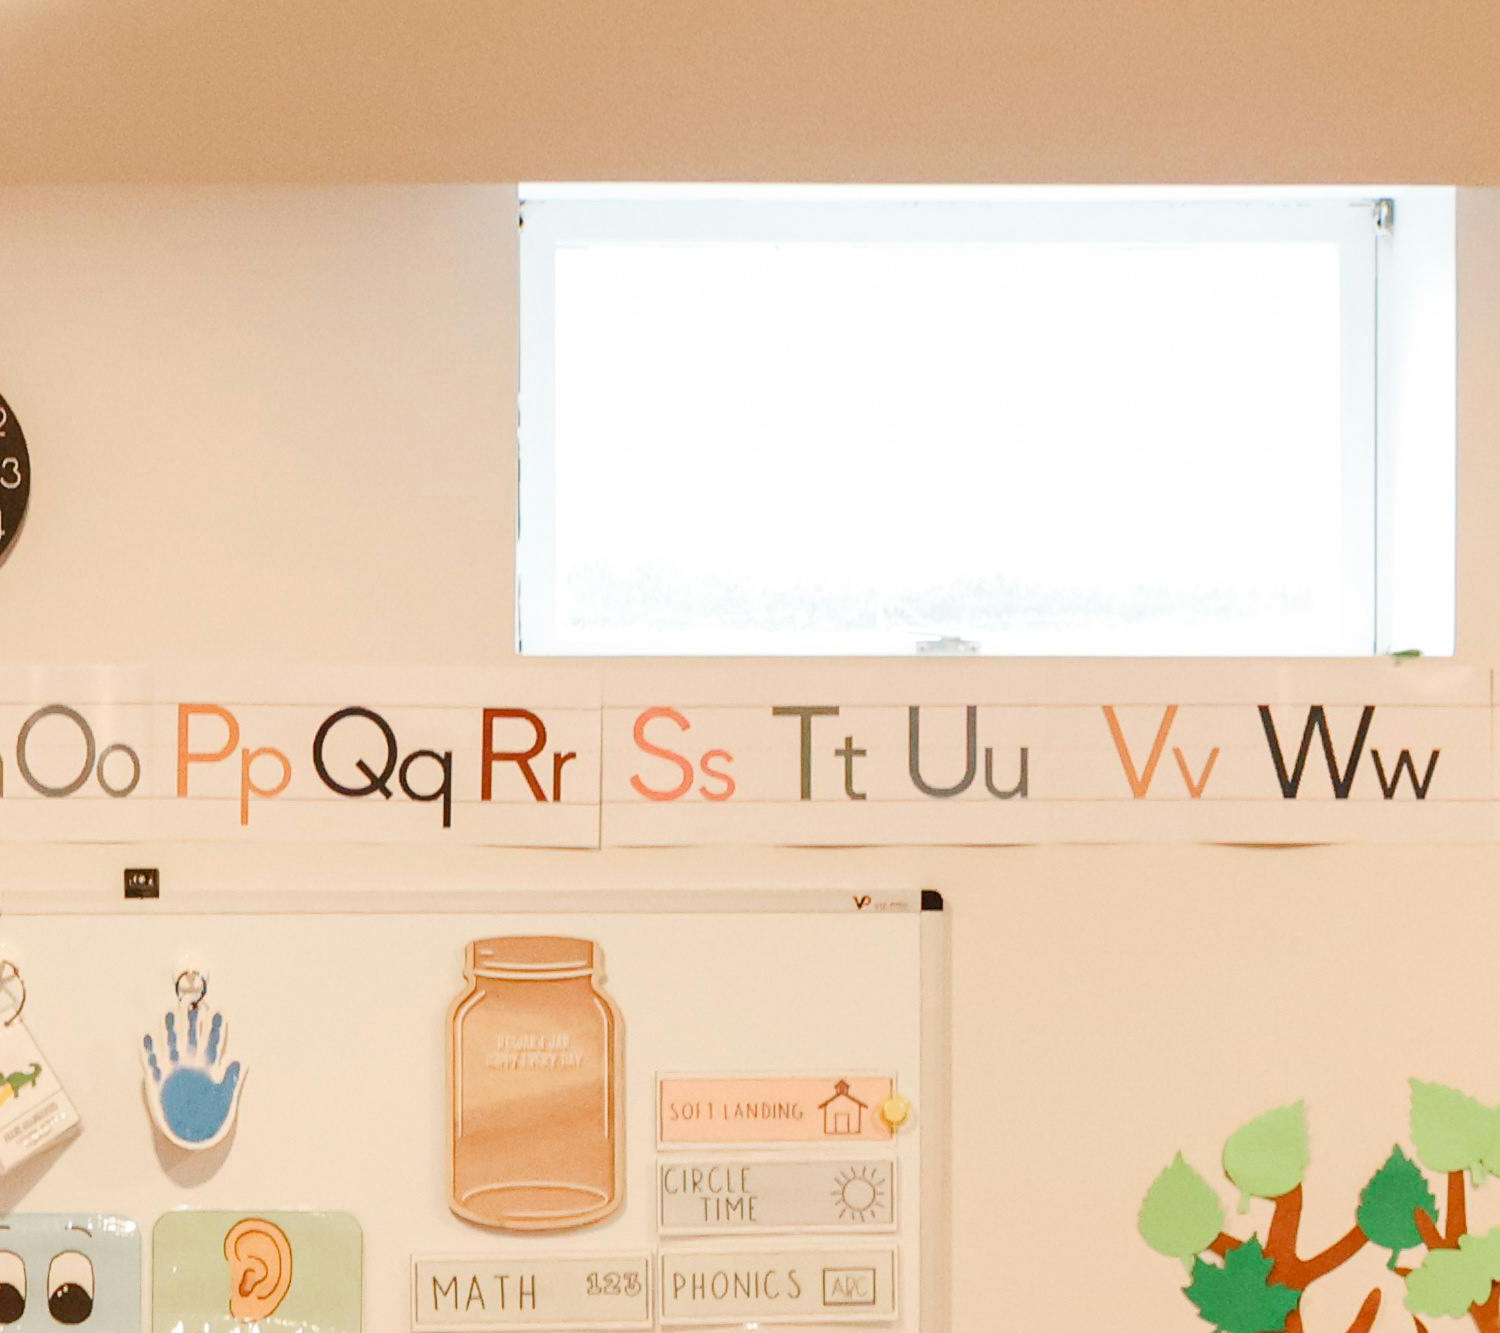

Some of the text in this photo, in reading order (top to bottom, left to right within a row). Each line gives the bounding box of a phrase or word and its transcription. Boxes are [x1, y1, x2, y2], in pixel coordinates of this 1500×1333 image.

[0, 456, 21, 489] 3
[16, 704, 141, 798] Oo
[176, 704, 292, 826] Pp
[312, 706, 453, 828] Qq
[480, 708, 577, 802] Rr
[630, 708, 736, 802] Ss
[772, 706, 867, 801] Tt
[908, 706, 1030, 800] Uu
[1102, 705, 1220, 798] Vv
[1257, 705, 1441, 800] Ww
[669, 1102, 805, 1122] SOFT LANDING
[664, 1166, 752, 1195] CIRCLE
[700, 1196, 758, 1223] TIME
[432, 1274, 538, 1312] MATH
[672, 1270, 803, 1302] PHONICS
